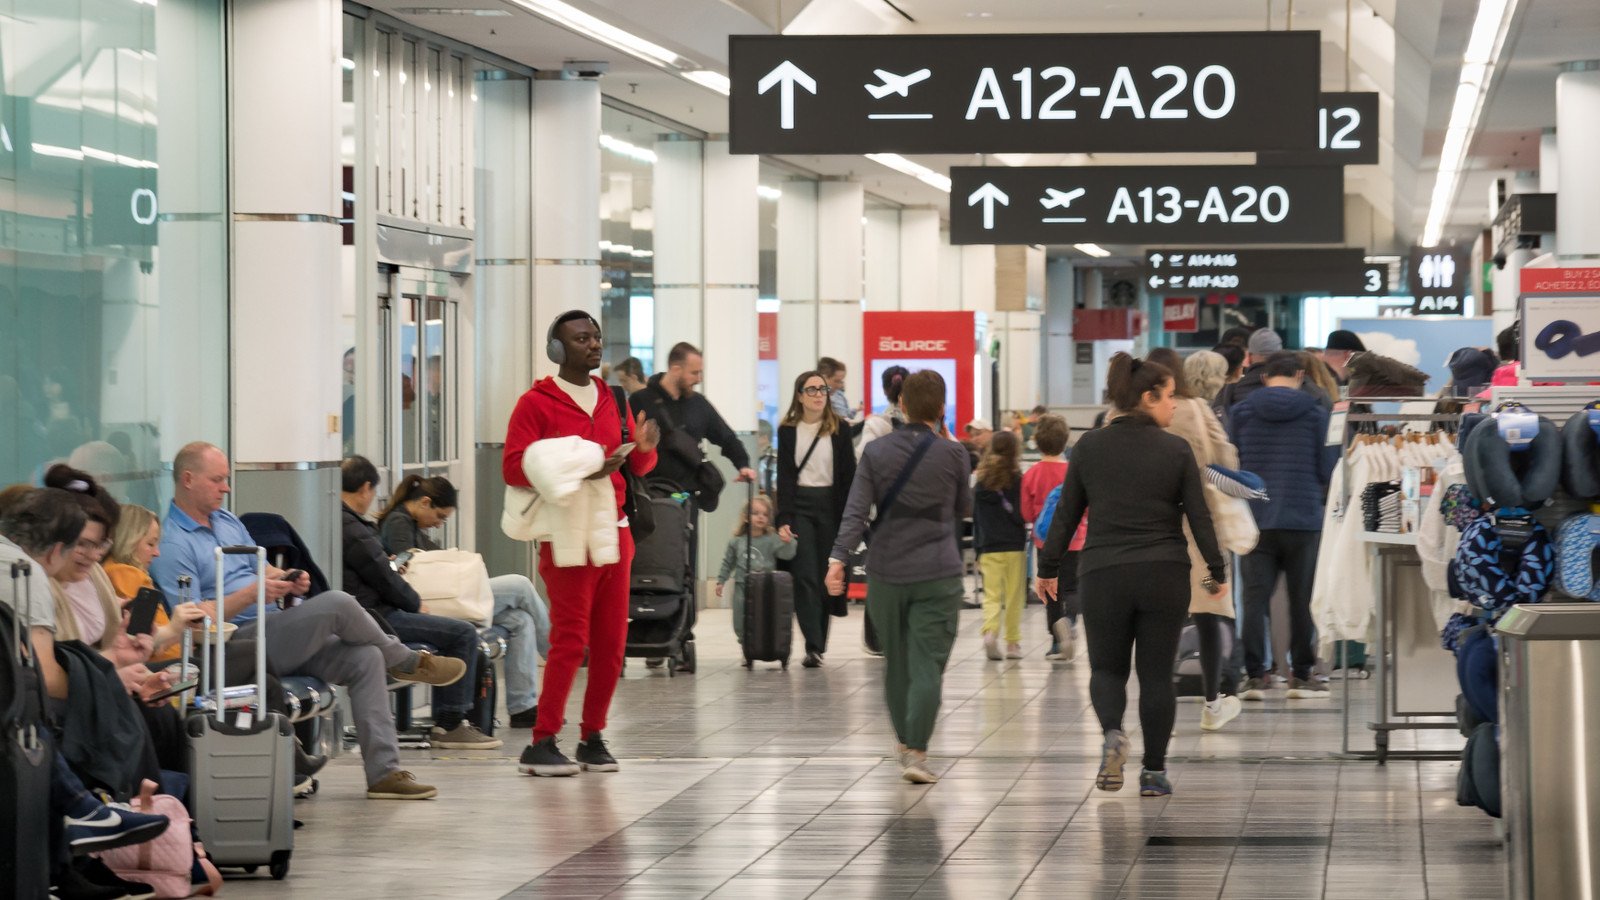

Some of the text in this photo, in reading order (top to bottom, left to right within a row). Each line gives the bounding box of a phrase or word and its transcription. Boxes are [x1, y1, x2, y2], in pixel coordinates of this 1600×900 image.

[965, 66, 1236, 120] A12-A20
[1106, 186, 1290, 224] A13-A20
[1187, 254, 1238, 267] A14-A16
[1564, 270, 1582, 279] BUY
[1584, 270, 1590, 279] 2
[1187, 275, 1240, 288] A17-A20
[1535, 281, 1576, 290] ACHETEZ
[1419, 295, 1459, 311] A14
[879, 340, 947, 352] SOURCE
